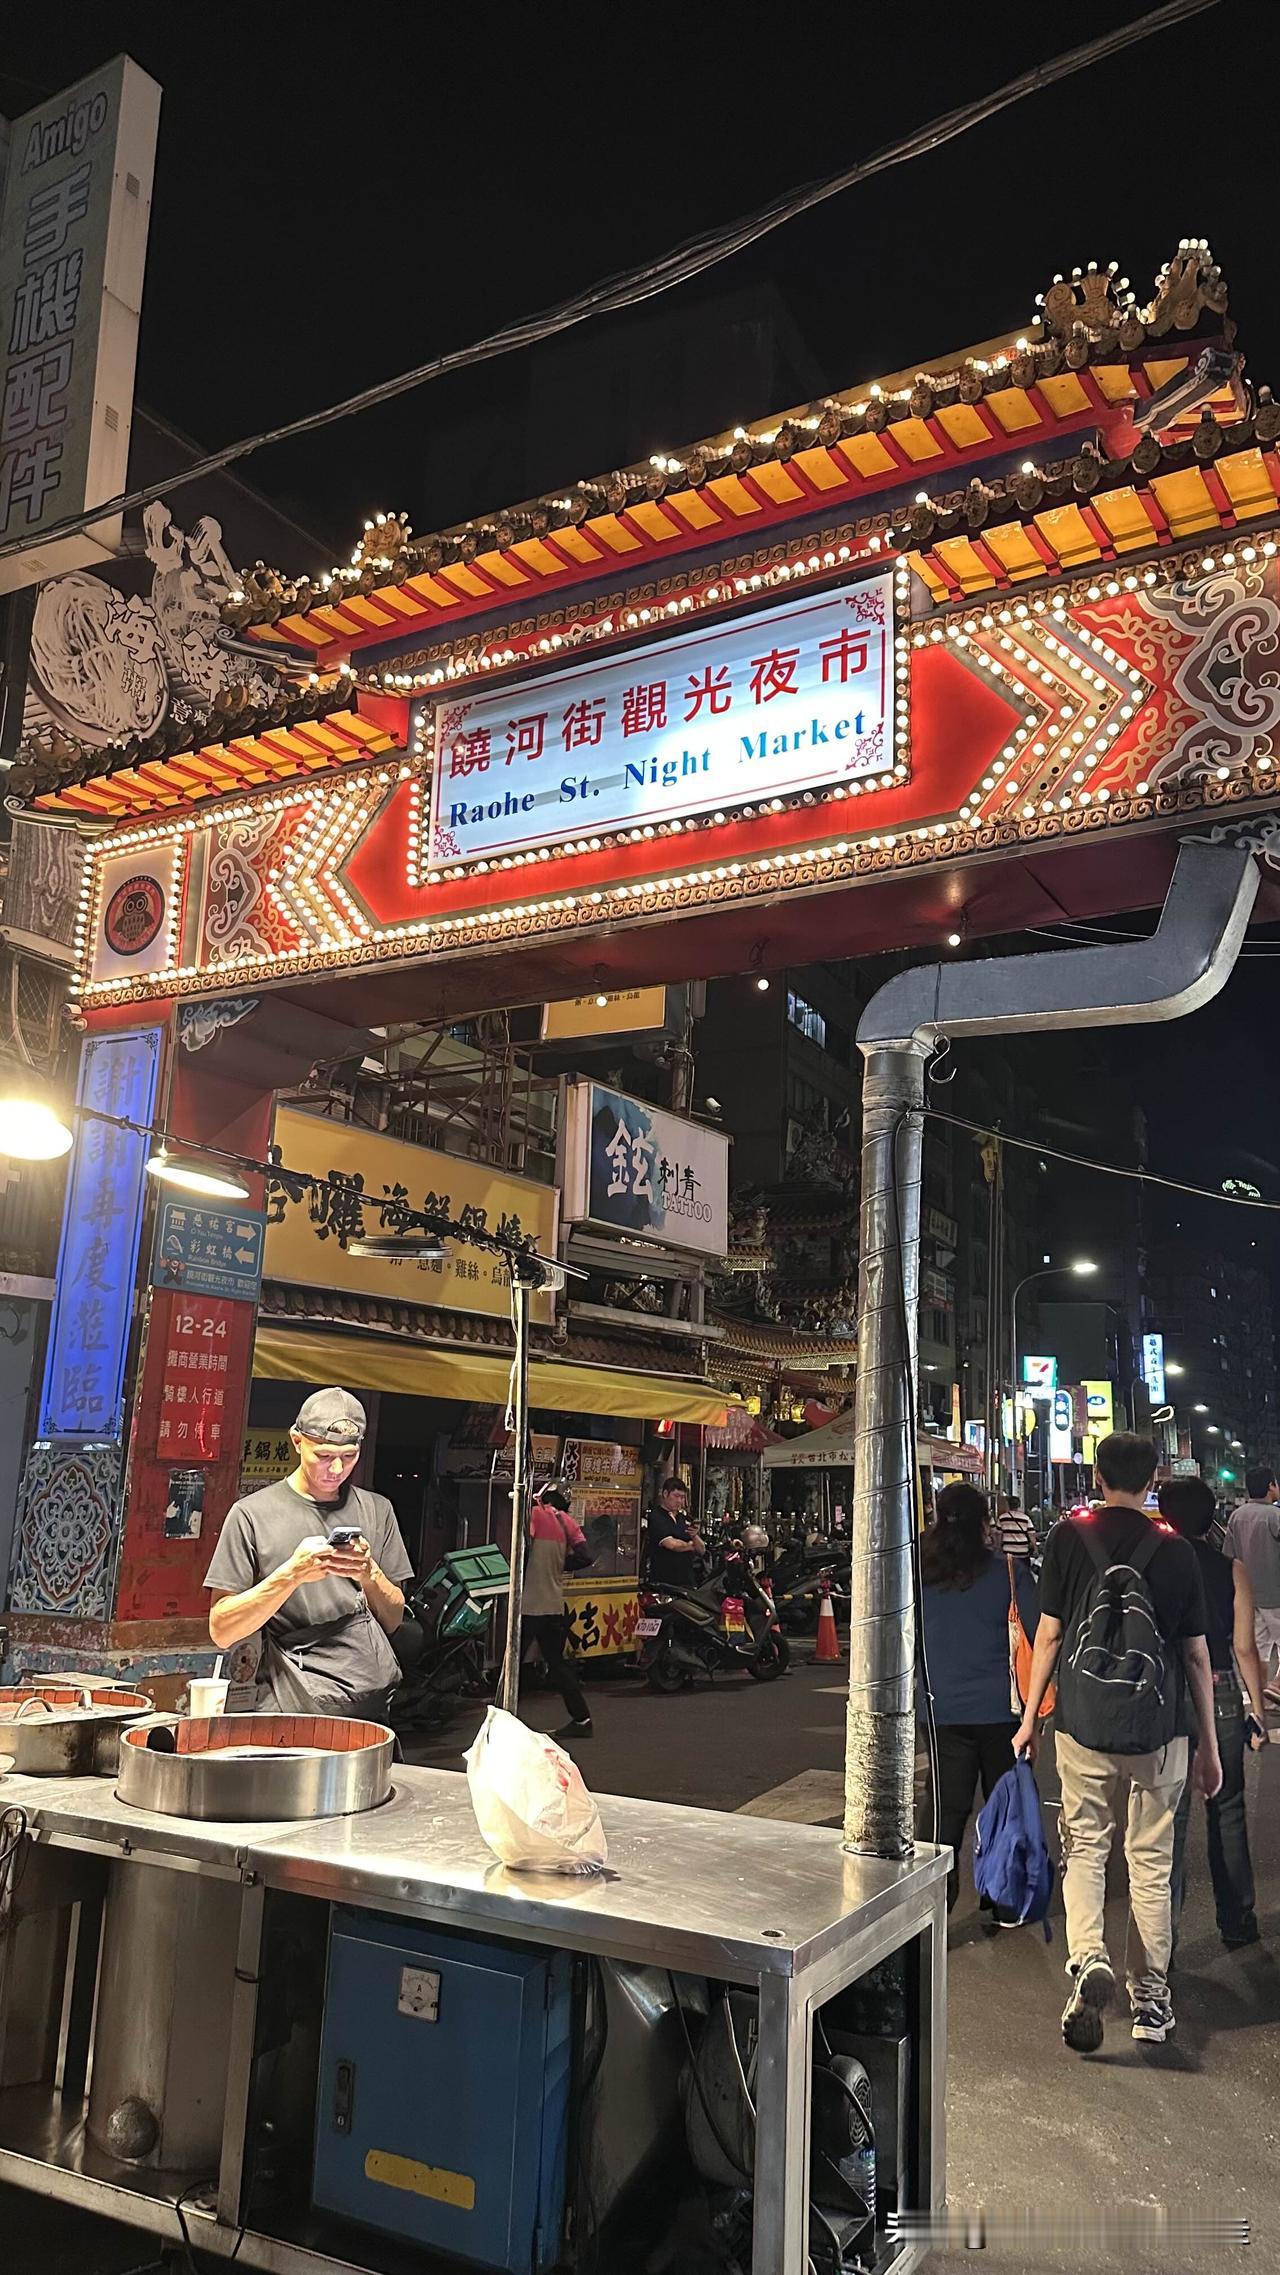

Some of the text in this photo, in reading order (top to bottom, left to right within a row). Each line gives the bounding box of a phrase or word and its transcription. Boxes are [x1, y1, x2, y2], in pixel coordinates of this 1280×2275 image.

[20, 91, 108, 176] Amigo
[0, 161, 93, 532] 手機配件
[449, 628, 871, 779] 饒河街觀光夜市
[449, 708, 868, 829] Raohe St. Night Market
[658, 1157, 702, 1201] 刺青
[661, 1190, 713, 1223] TATTOO
[190, 1238, 233, 1260] 彩虹橋
[176, 1314, 227, 1339] 12-24
[167, 1349, 229, 1372] 攤商營業時間
[164, 1384, 225, 1408] 騎樓人行道
[159, 1420, 222, 1440] 請勿停車
